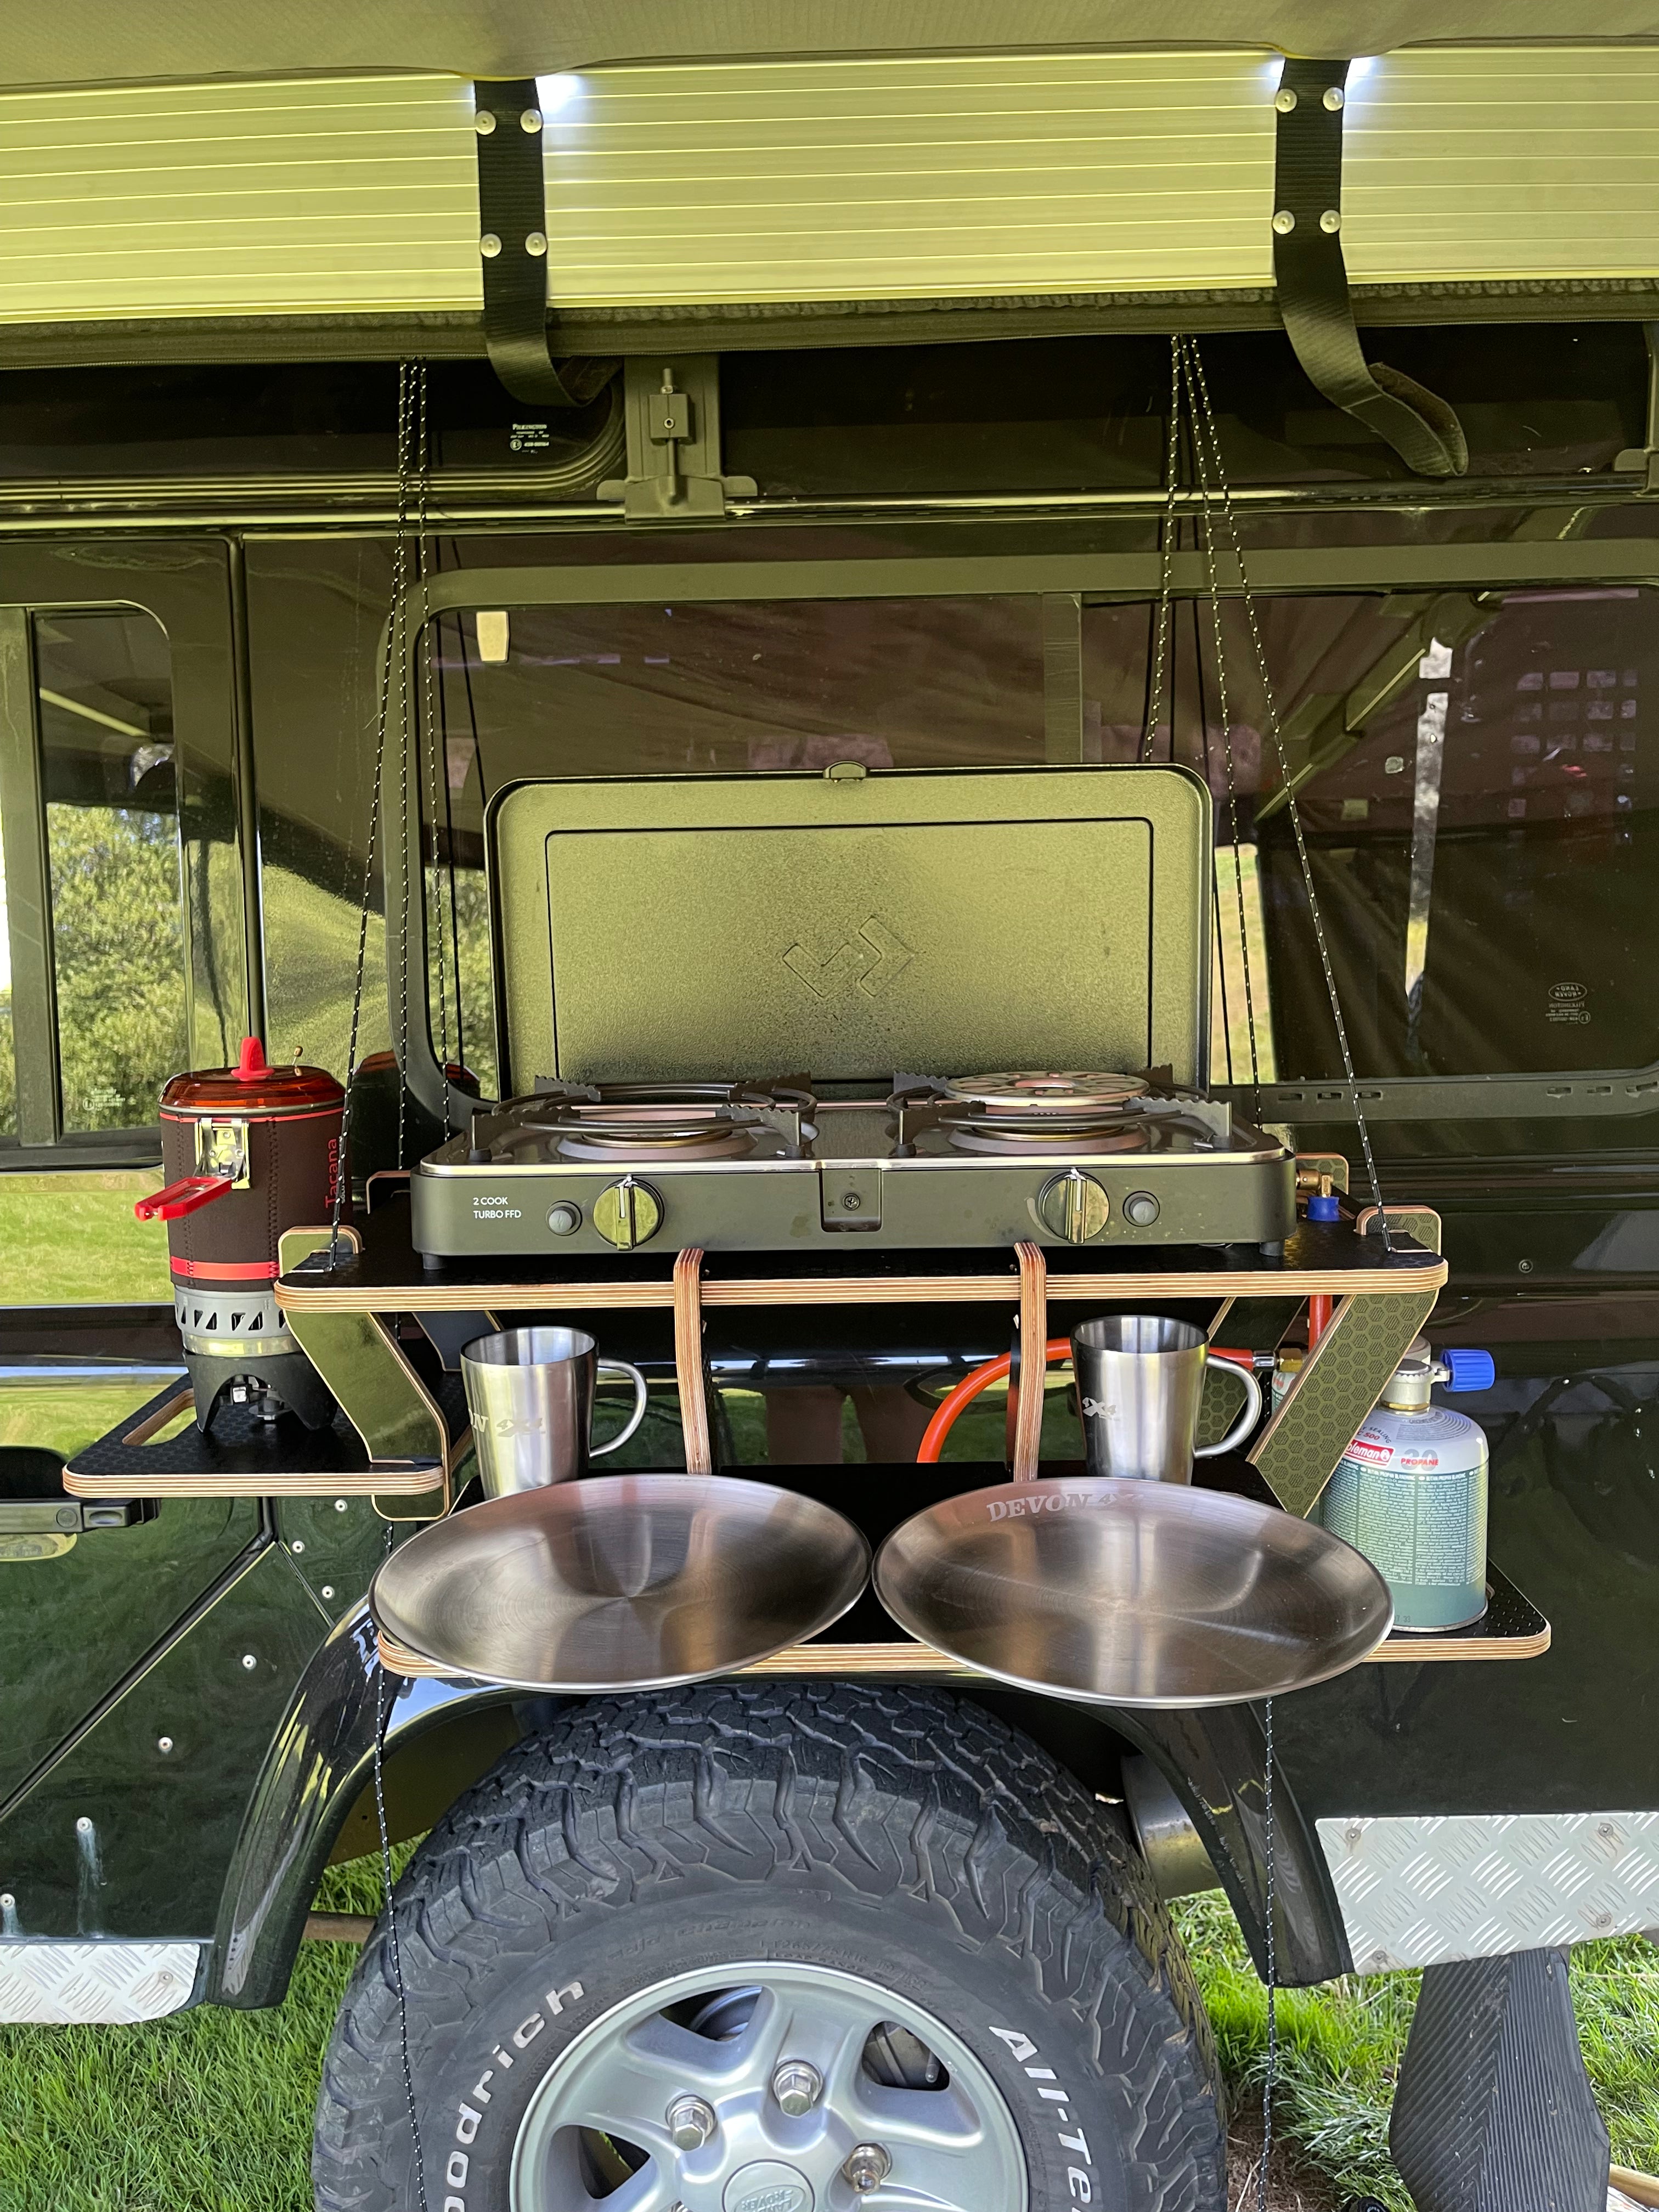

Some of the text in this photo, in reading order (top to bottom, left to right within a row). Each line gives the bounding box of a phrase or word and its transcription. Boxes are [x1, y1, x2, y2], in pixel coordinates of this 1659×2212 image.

[325, 1138, 338, 1208] Tacana
[473, 1197, 508, 1205] 2 COOK
[473, 1210, 522, 1219] TURBO FFD
[1370, 1427, 1391, 1443] SEALING
[1346, 1442, 1380, 1460] oleman
[986, 1493, 1093, 1522] DEVON
[989, 2026, 1092, 2212] All-Te
